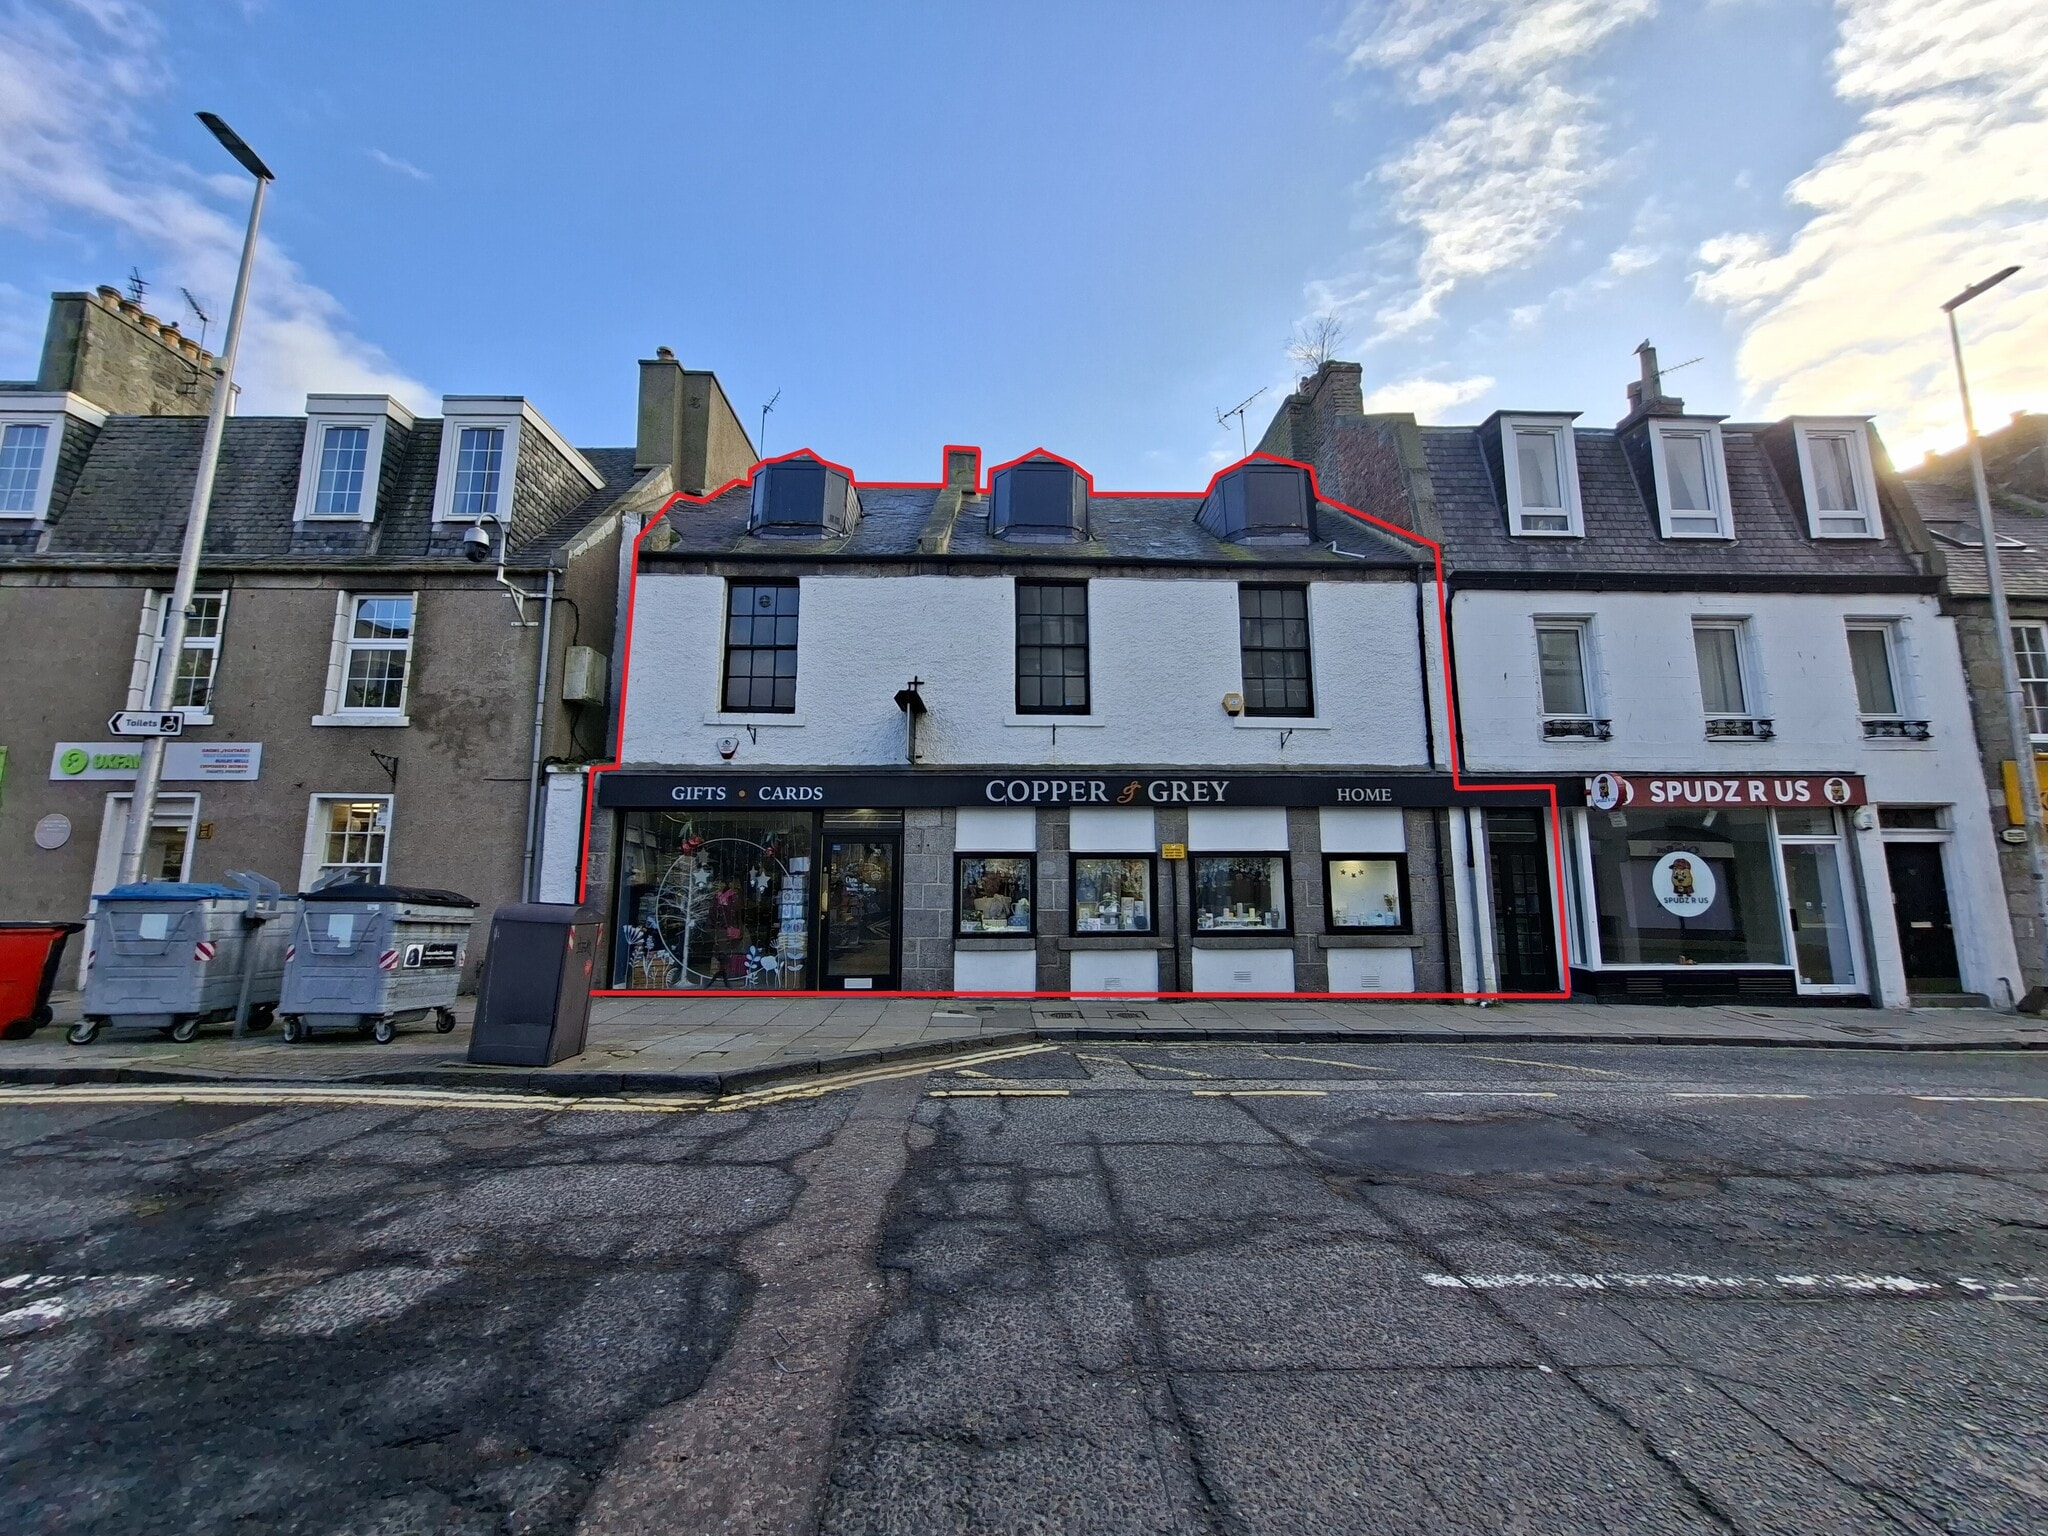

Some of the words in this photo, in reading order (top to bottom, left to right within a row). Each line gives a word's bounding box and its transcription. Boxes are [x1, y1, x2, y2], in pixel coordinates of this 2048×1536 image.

[126, 719, 157, 728] Toilets
[671, 786, 727, 801] GIFTS
[758, 786, 824, 801] CARDS
[985, 780, 1109, 802] COPPER
[1147, 780, 1230, 802] GREY
[1336, 788, 1392, 802] HOME
[1649, 780, 1742, 803] SPUDZ
[1747, 780, 1768, 802] R
[1774, 780, 1811, 802] US
[1663, 896, 1690, 904] SPUDZ
[1691, 896, 1697, 904] R
[1698, 896, 1709, 904] US
